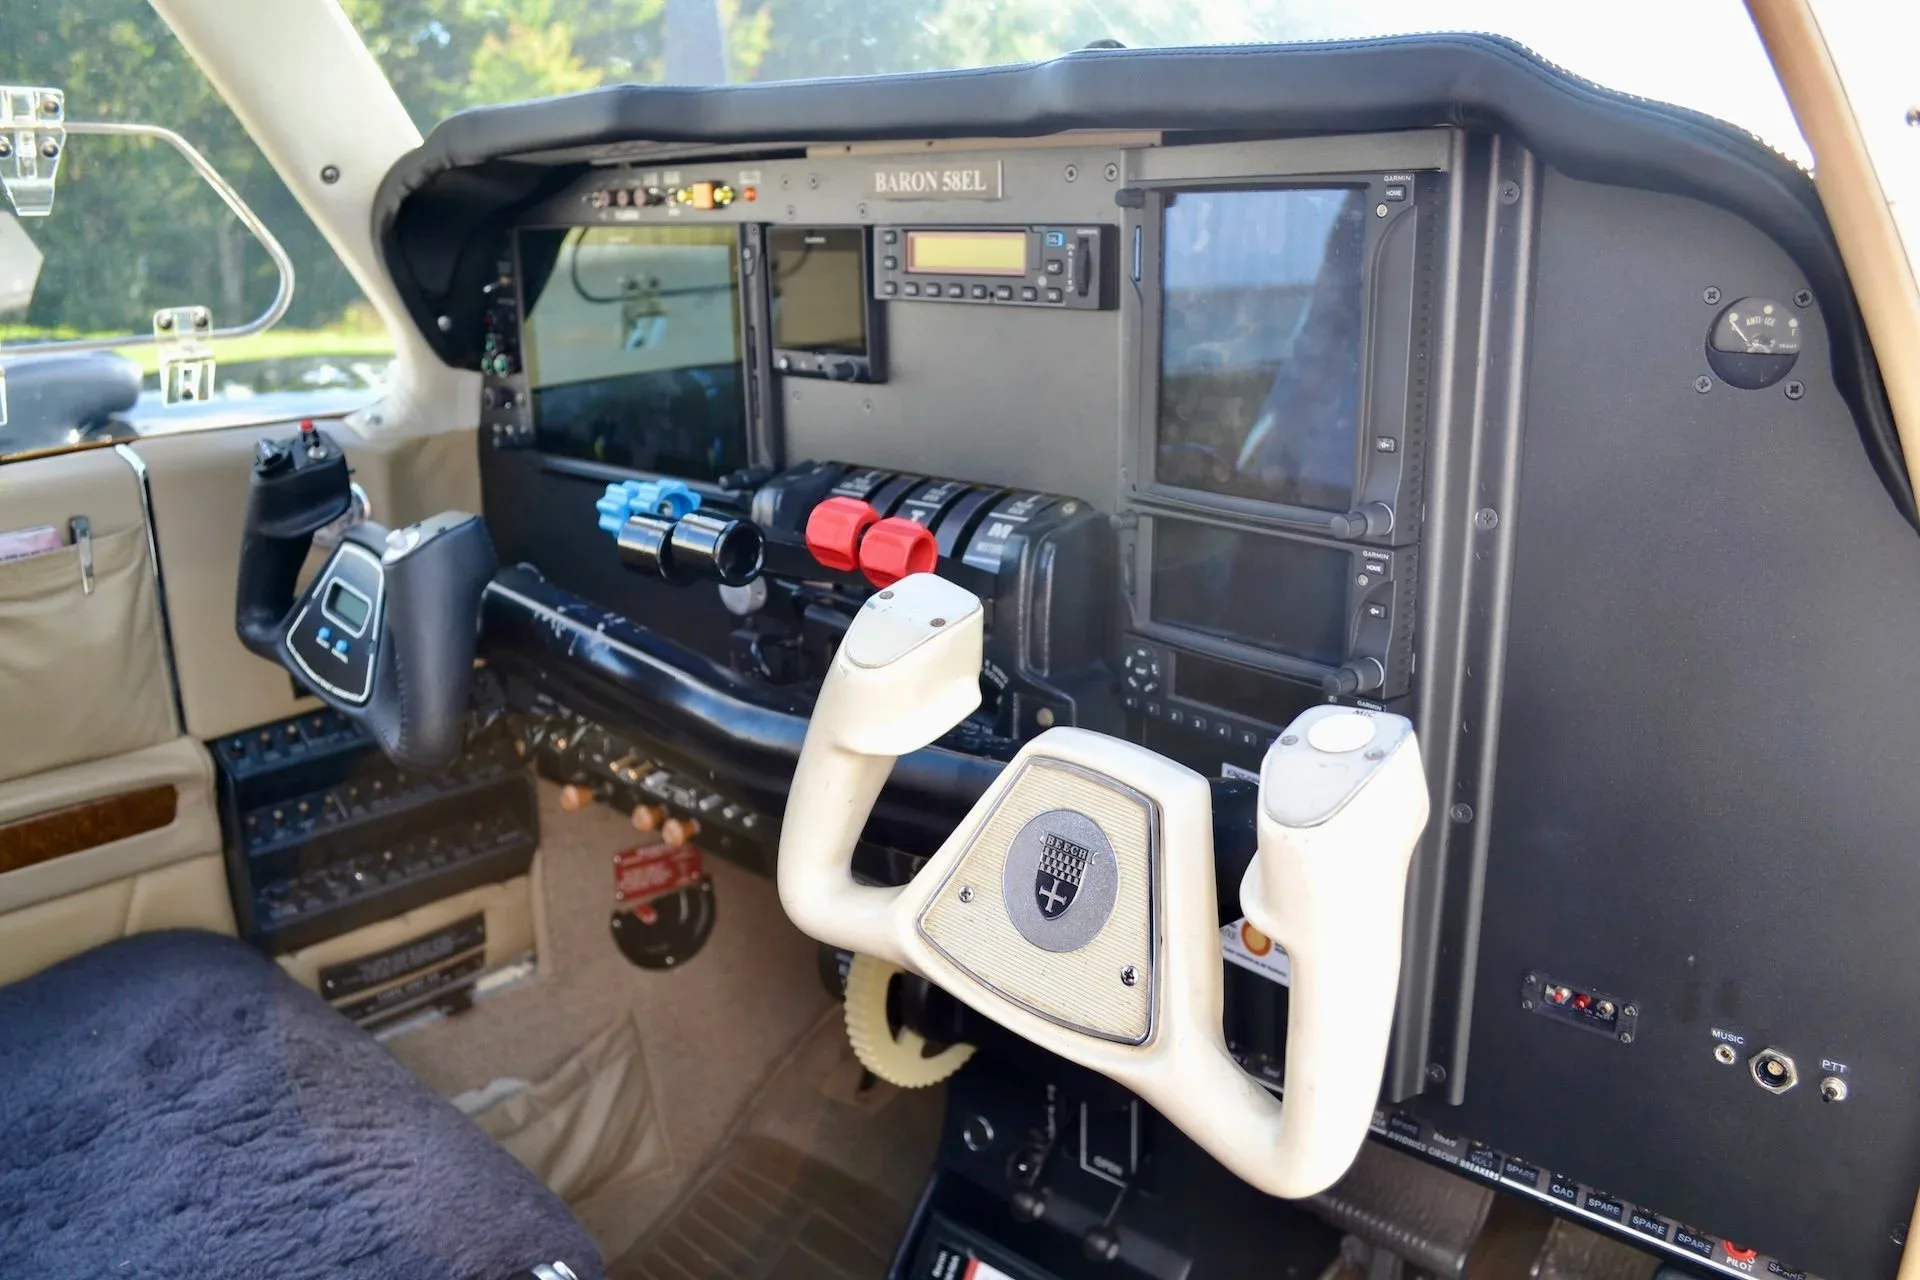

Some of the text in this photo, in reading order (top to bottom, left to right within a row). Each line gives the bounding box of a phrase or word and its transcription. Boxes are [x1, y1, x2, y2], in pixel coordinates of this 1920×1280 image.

[875, 169, 987, 193] BARON 58EL
[1362, 550, 1390, 560] GARMIN
[1047, 835, 1088, 860] BEECH
[1712, 1029, 1744, 1045] MUSIC
[1821, 1059, 1847, 1073] PTT
[1387, 1130, 1427, 1152] AVIONICS
[1428, 1146, 1459, 1165] CIRCUIT
[1459, 1158, 1500, 1181] BREAKERS
[1506, 1163, 1537, 1181] SPARE
[1588, 1197, 1620, 1216] SPARE
[1632, 1215, 1665, 1235] SPARE
[1677, 1232, 1712, 1254] SPARE
[1726, 1256, 1753, 1272] PILOT
